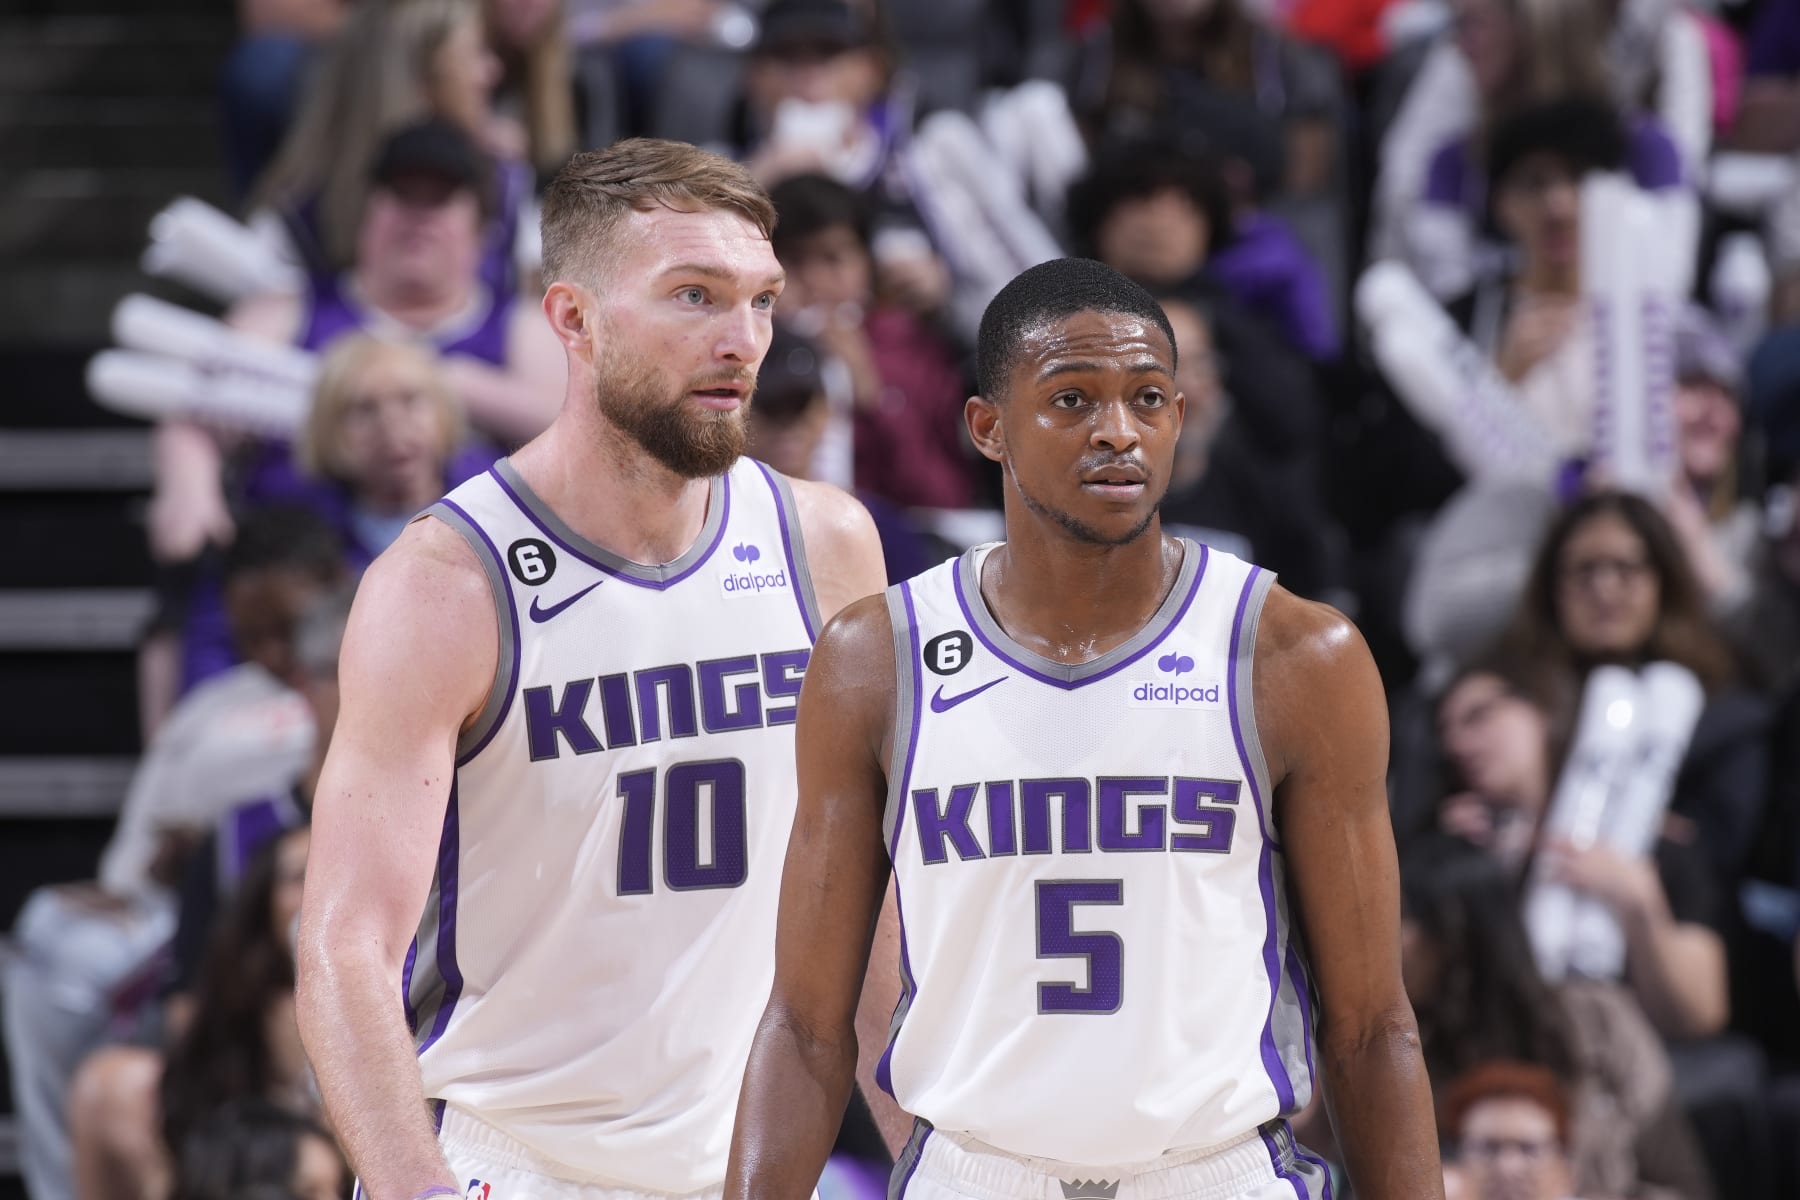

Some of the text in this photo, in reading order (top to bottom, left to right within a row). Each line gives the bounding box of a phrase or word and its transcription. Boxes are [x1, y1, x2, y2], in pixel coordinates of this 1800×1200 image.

[514, 544, 547, 581] 6
[723, 569, 787, 593] dialpad
[936, 636, 962, 670] 6
[523, 648, 811, 763] KINGS
[1133, 682, 1219, 704] dialpad
[616, 757, 749, 897] 10
[911, 775, 1242, 866] KINGS
[1034, 878, 1124, 1016] 5
